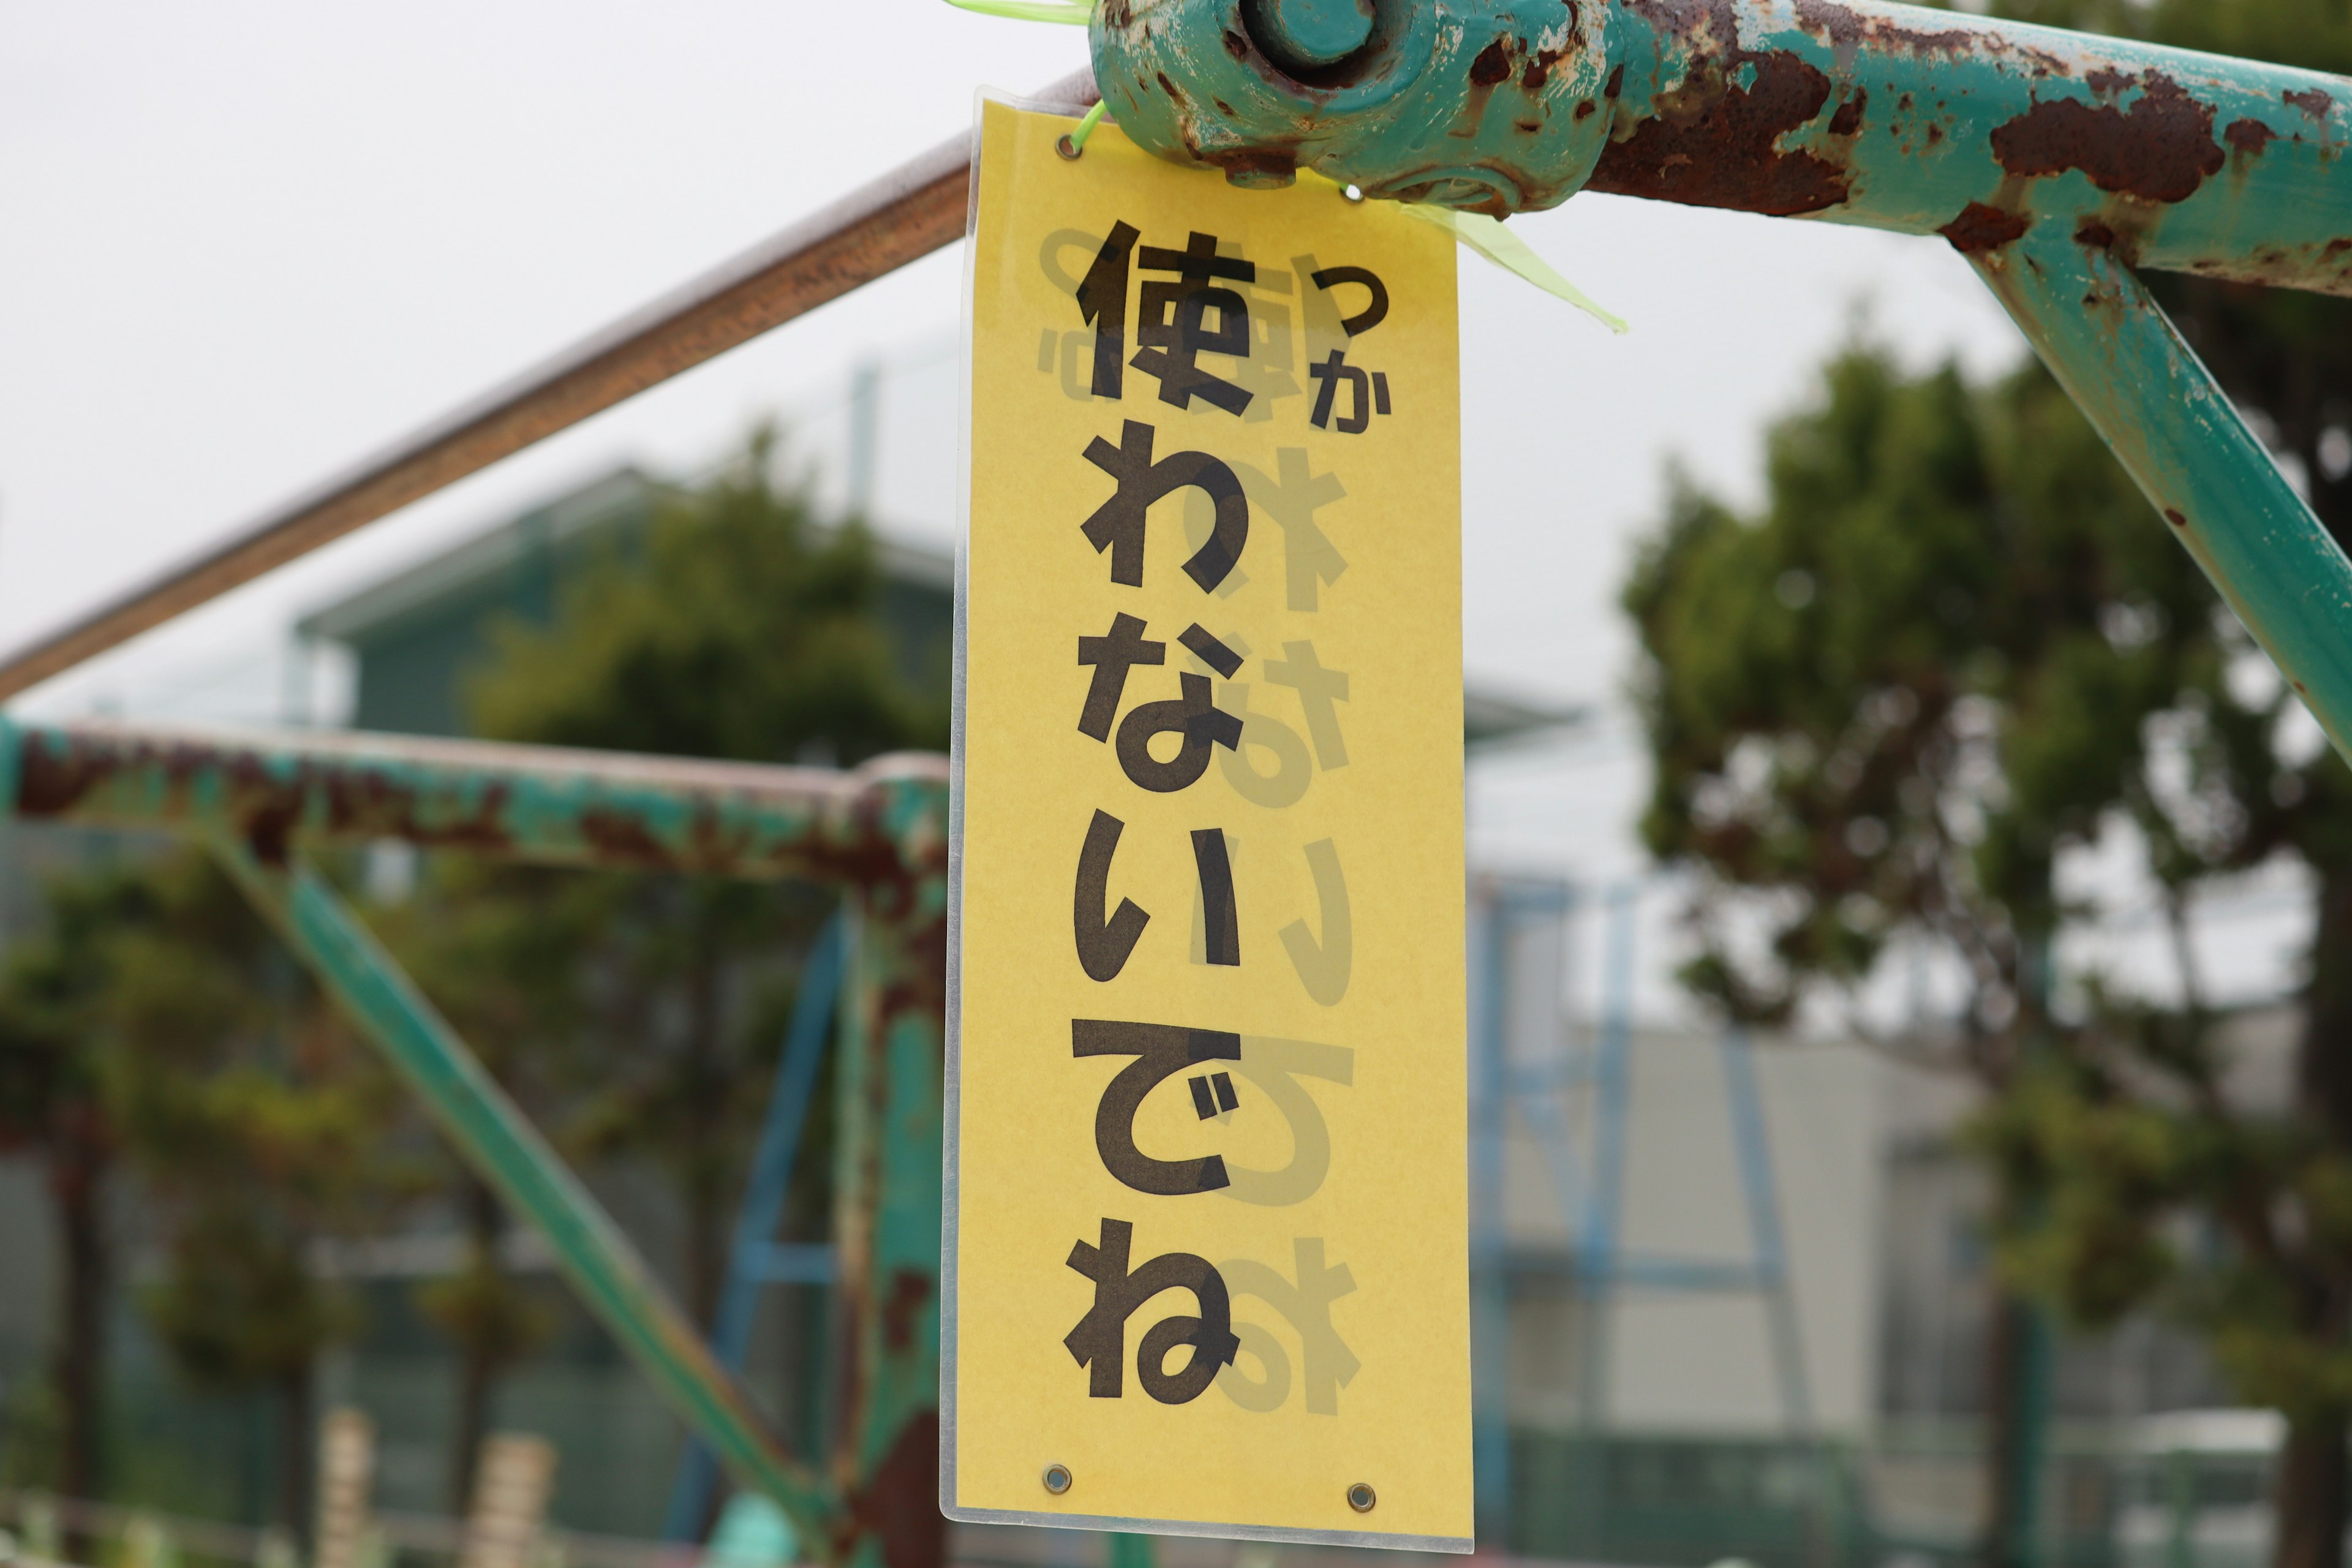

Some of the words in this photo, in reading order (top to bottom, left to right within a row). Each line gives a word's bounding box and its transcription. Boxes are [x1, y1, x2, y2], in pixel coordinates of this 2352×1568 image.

[1310, 266, 1392, 434] つか
[1063, 219, 1255, 1404] 使わないでね
